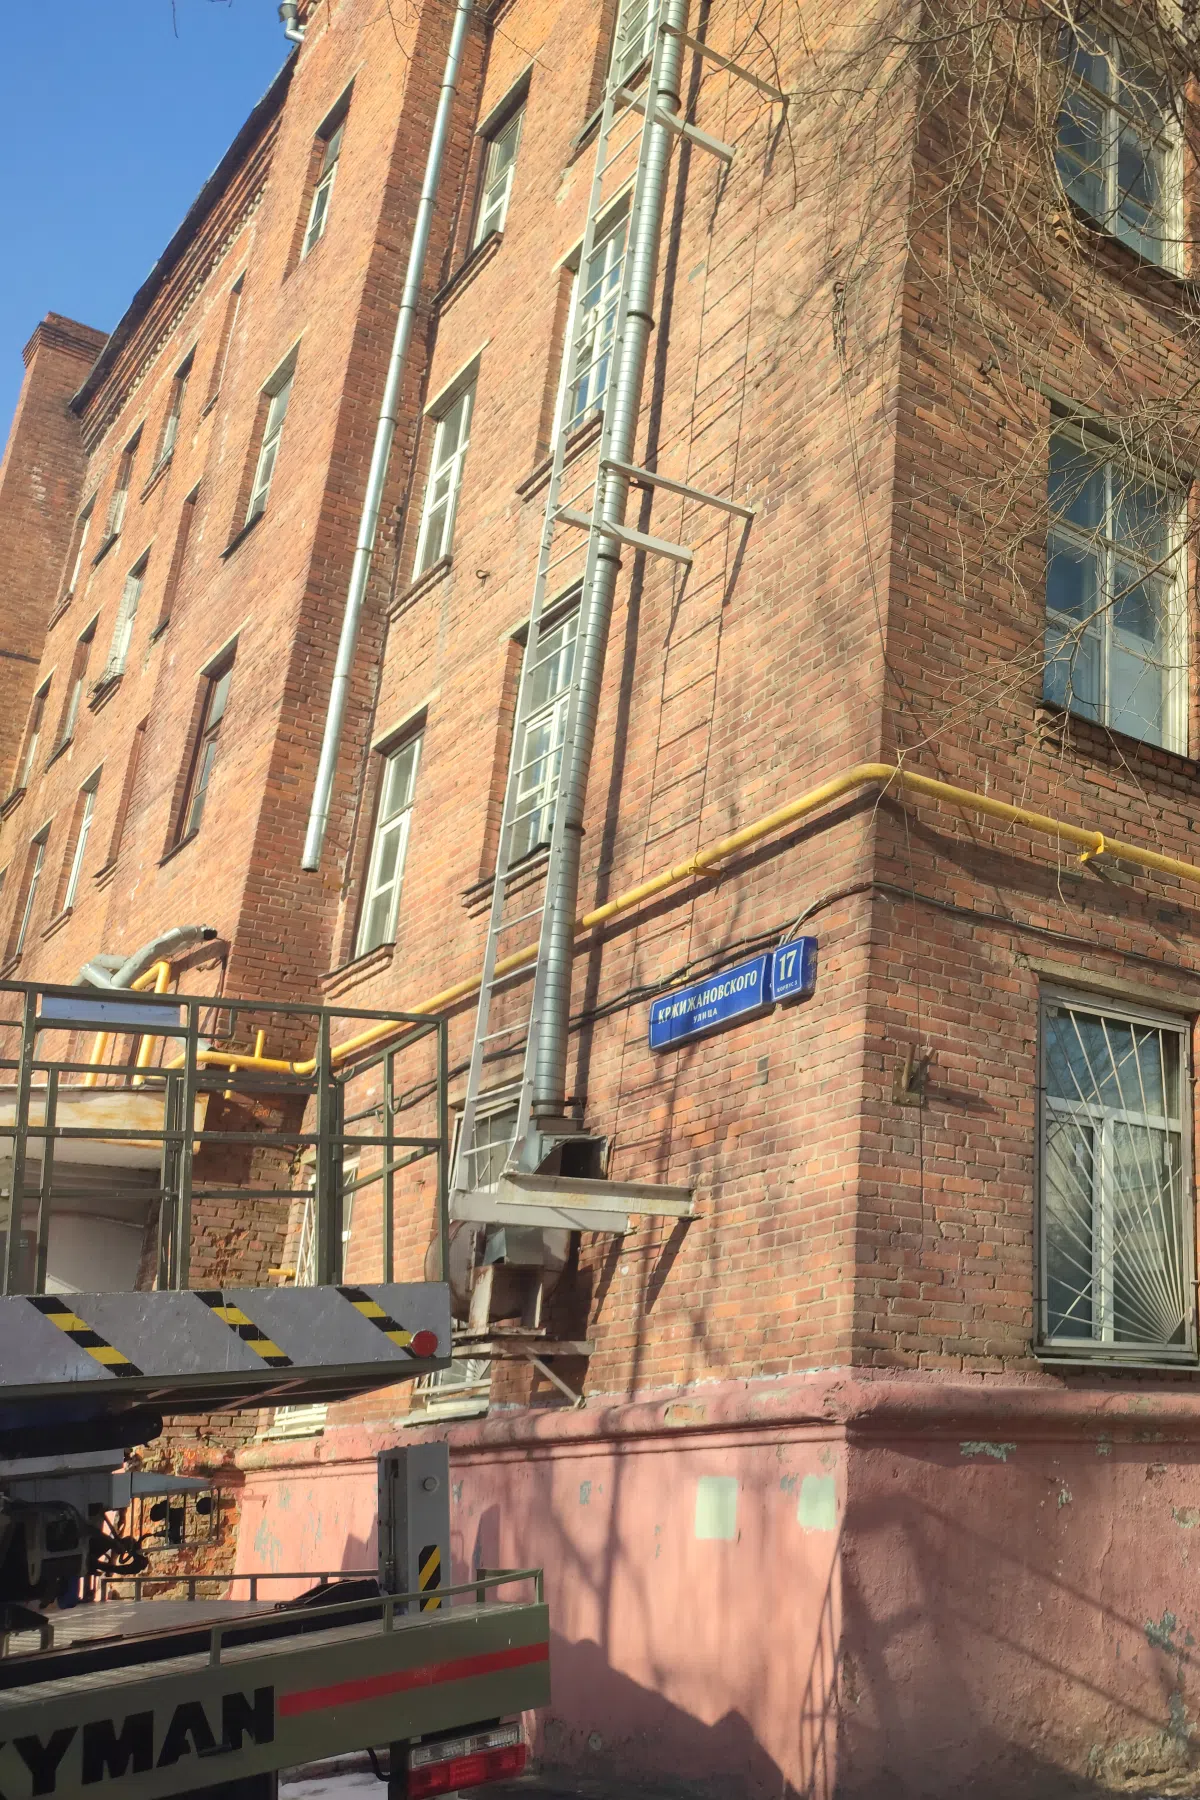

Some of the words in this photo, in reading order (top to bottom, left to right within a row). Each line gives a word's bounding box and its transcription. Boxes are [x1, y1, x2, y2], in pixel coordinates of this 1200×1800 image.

[779, 949, 798, 981] 17
[657, 969, 758, 1025] КРЖИЖАНОВСКОГО
[693, 1007, 718, 1024] УЛИЦА
[0, 1685, 275, 1800] YMAN
